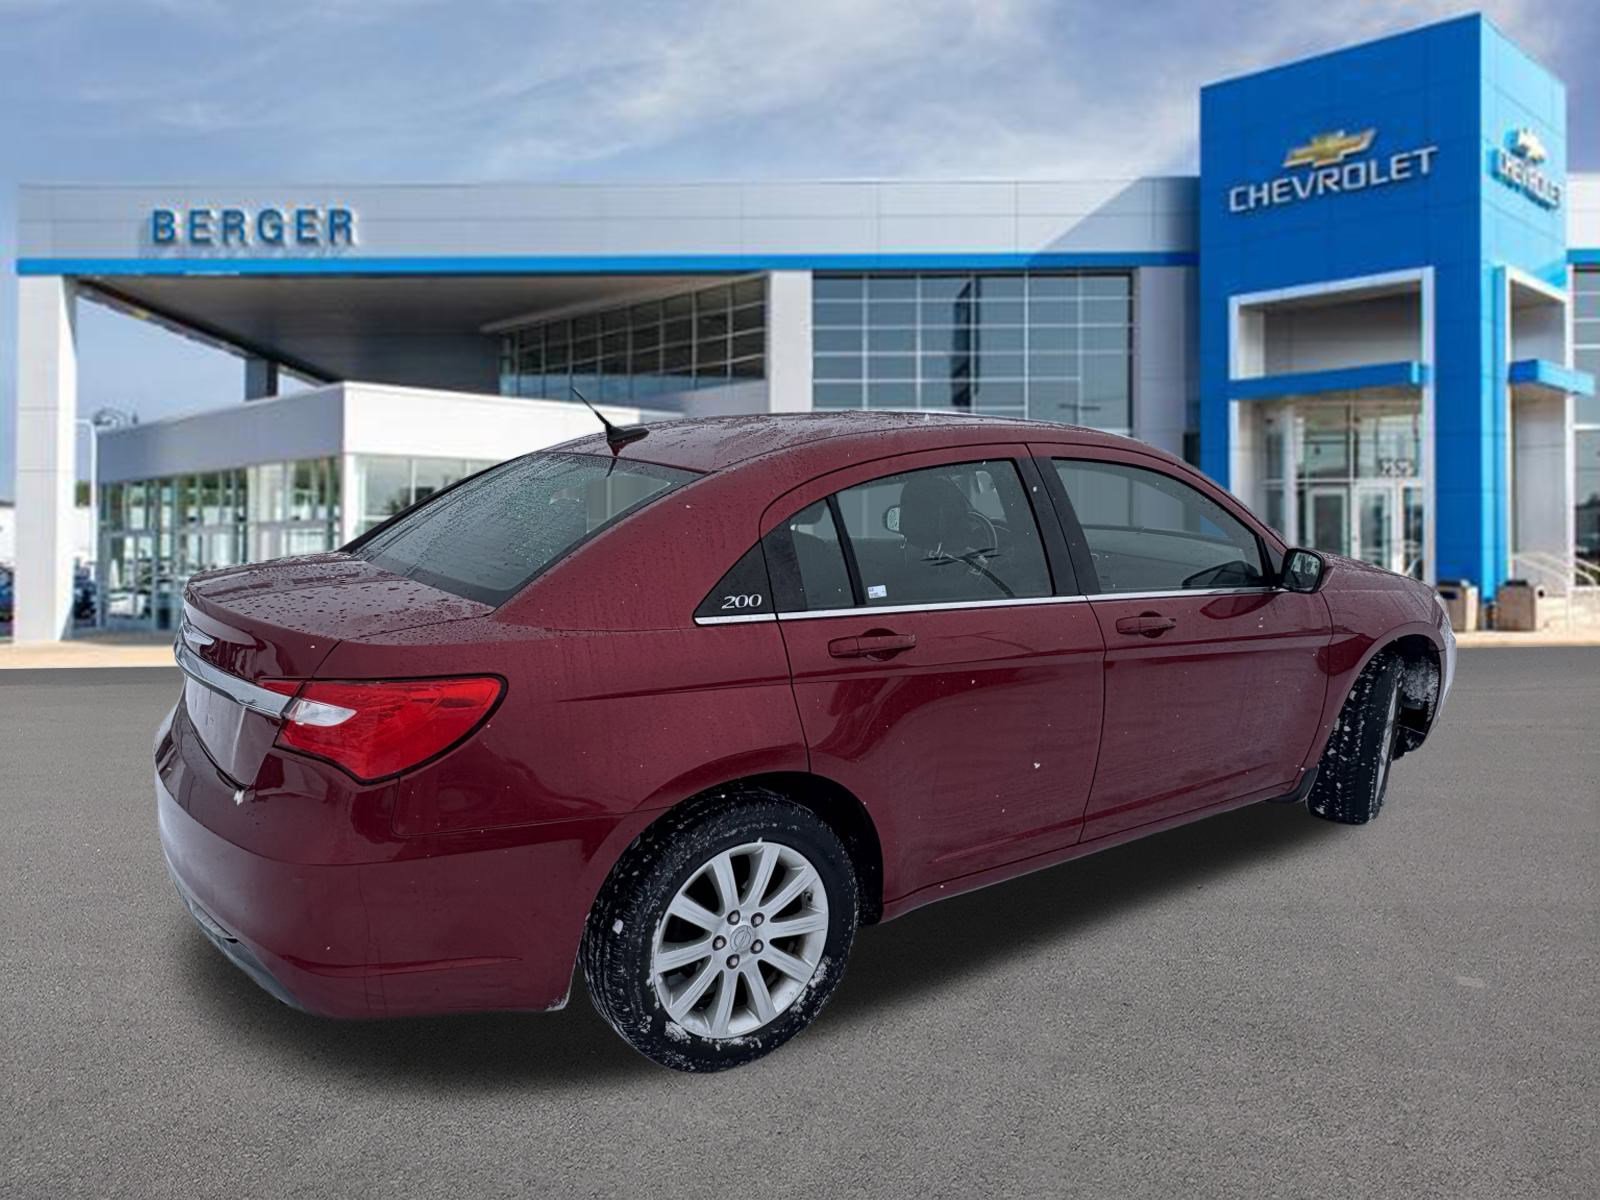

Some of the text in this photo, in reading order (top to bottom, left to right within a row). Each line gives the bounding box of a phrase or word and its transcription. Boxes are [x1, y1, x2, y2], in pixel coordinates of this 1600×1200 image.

[1229, 146, 1438, 213] CHEVROLET
[152, 208, 355, 247] BERGER
[721, 594, 762, 609] 200
